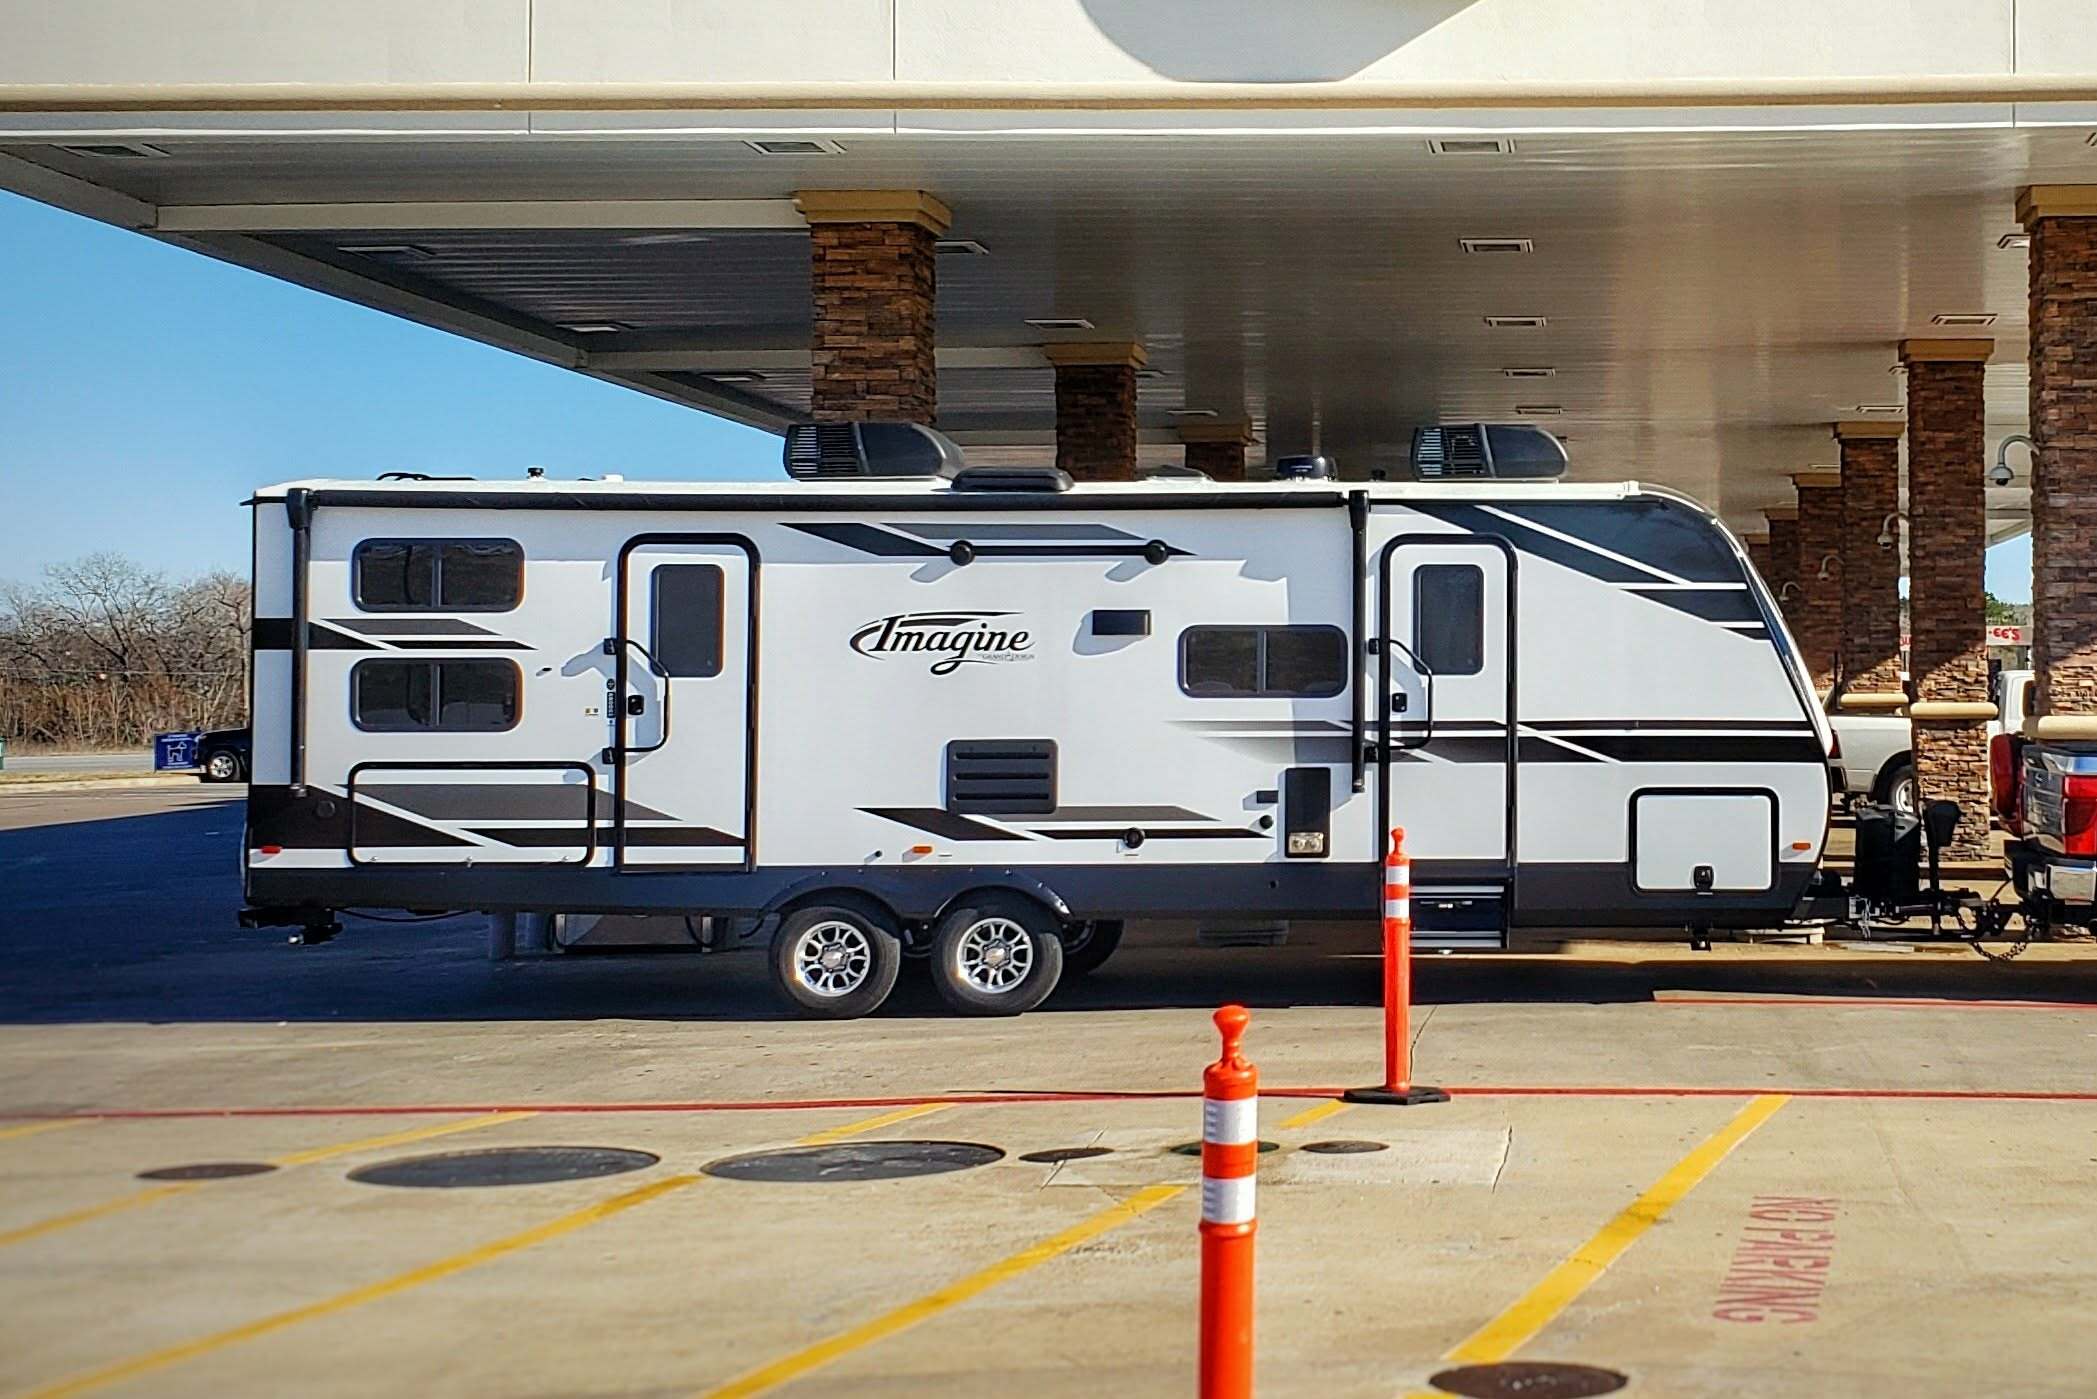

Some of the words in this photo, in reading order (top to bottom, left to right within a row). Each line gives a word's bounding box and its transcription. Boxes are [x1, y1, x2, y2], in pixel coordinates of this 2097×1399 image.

[850, 611, 1036, 676] Imagine
[1748, 1195, 1840, 1222] NO
[1712, 1226, 1836, 1323] PARKING
